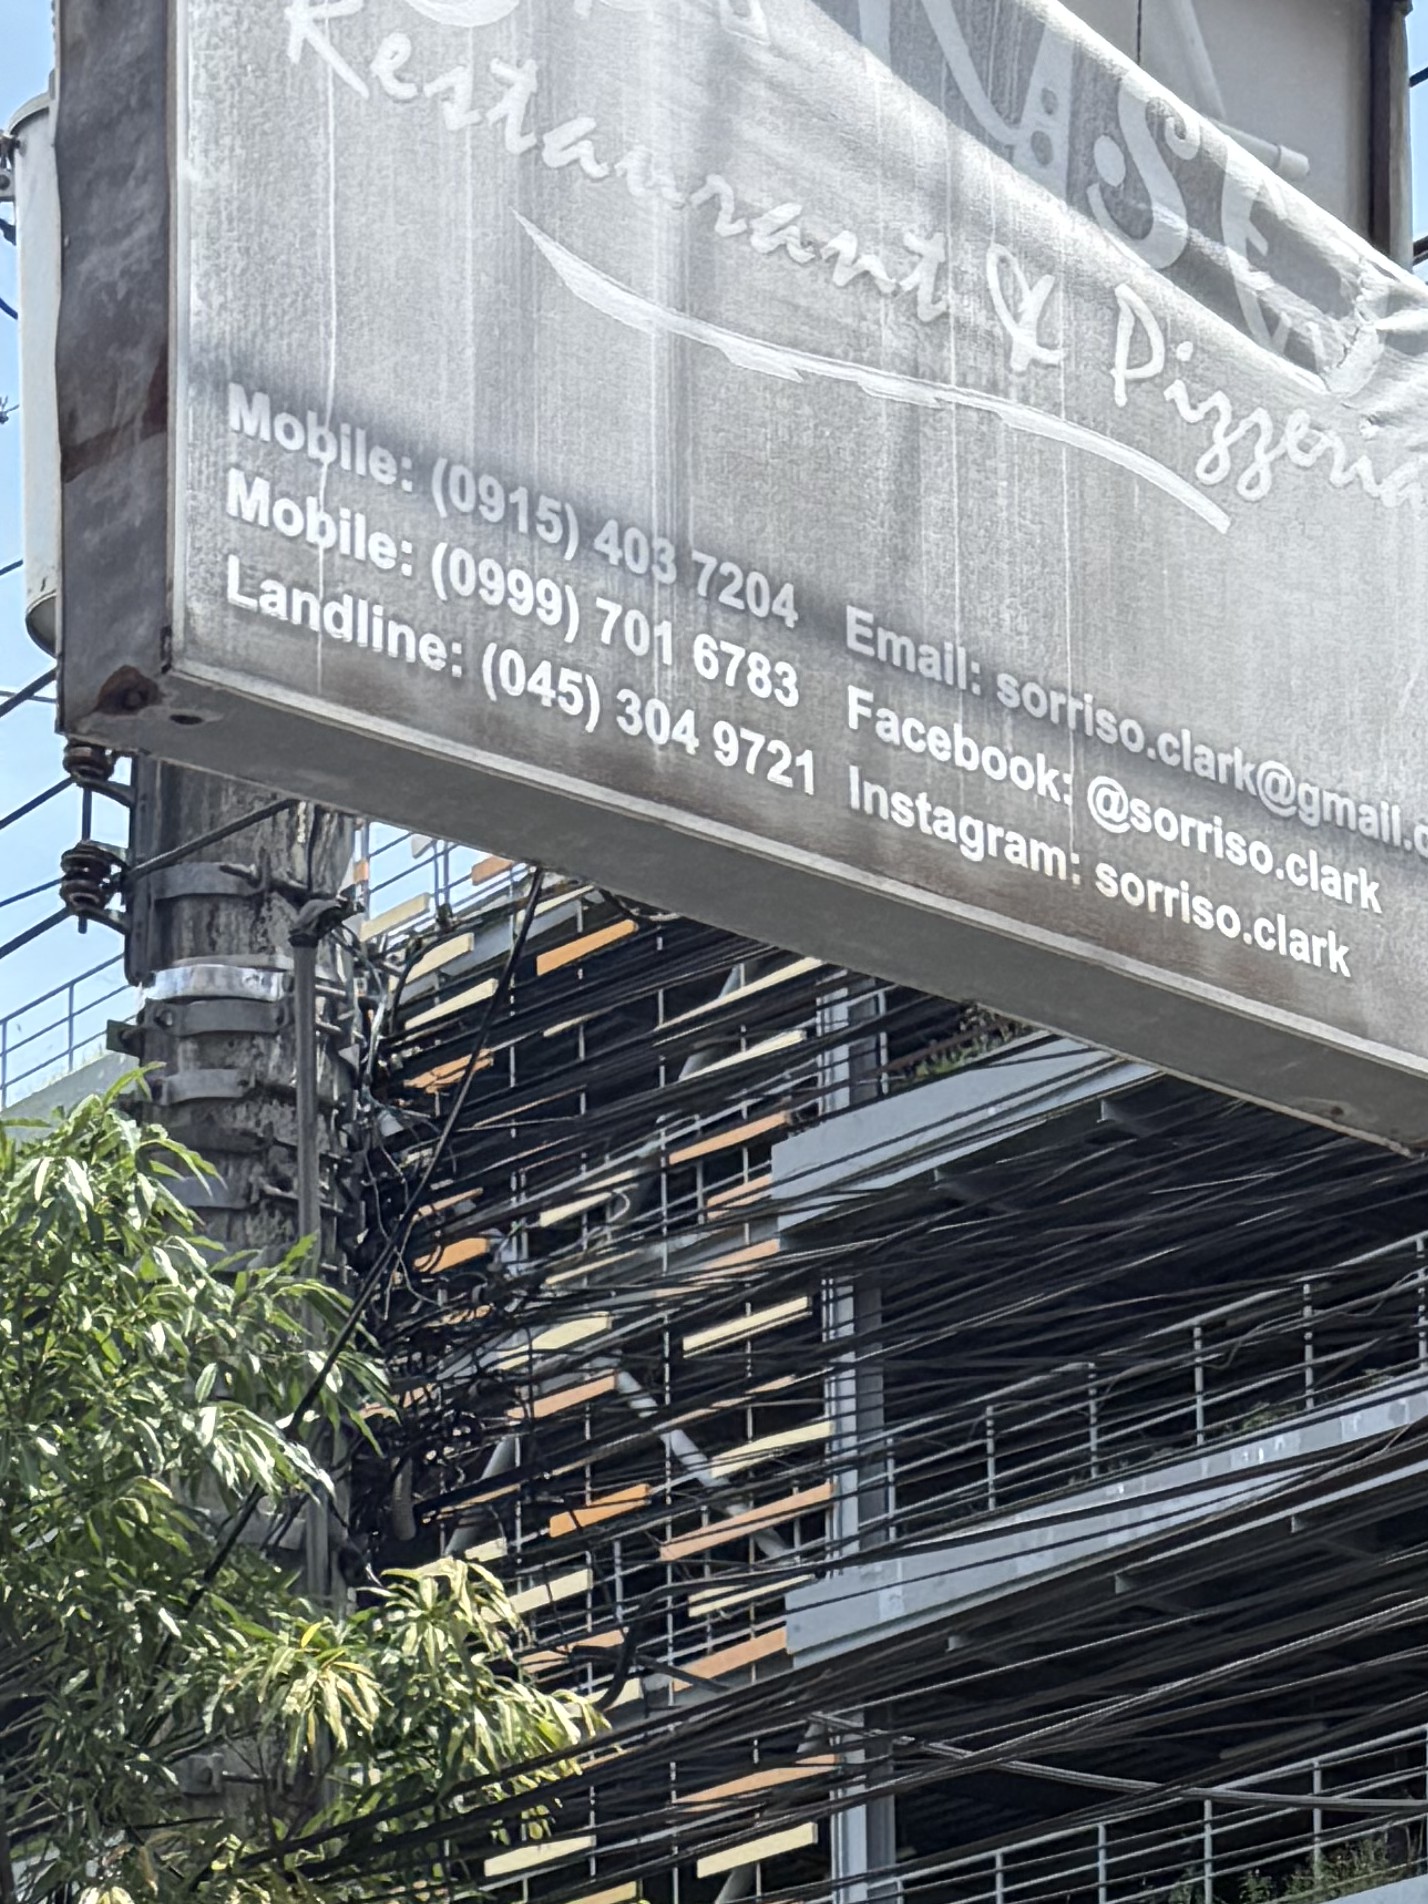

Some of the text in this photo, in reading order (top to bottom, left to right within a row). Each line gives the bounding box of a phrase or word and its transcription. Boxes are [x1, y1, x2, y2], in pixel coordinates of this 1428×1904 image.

[226, 467, 799, 708] Mobile: (0999) 701 6783
[228, 382, 799, 629] Mobile: (0915) 403 7204
[226, 555, 814, 795] Landline: (045) 304 9721
[845, 606, 982, 696] Email:
[846, 684, 1382, 915] Facebook: @sorriso.clark
[848, 765, 1351, 978] Instagram: sorriso.clark
